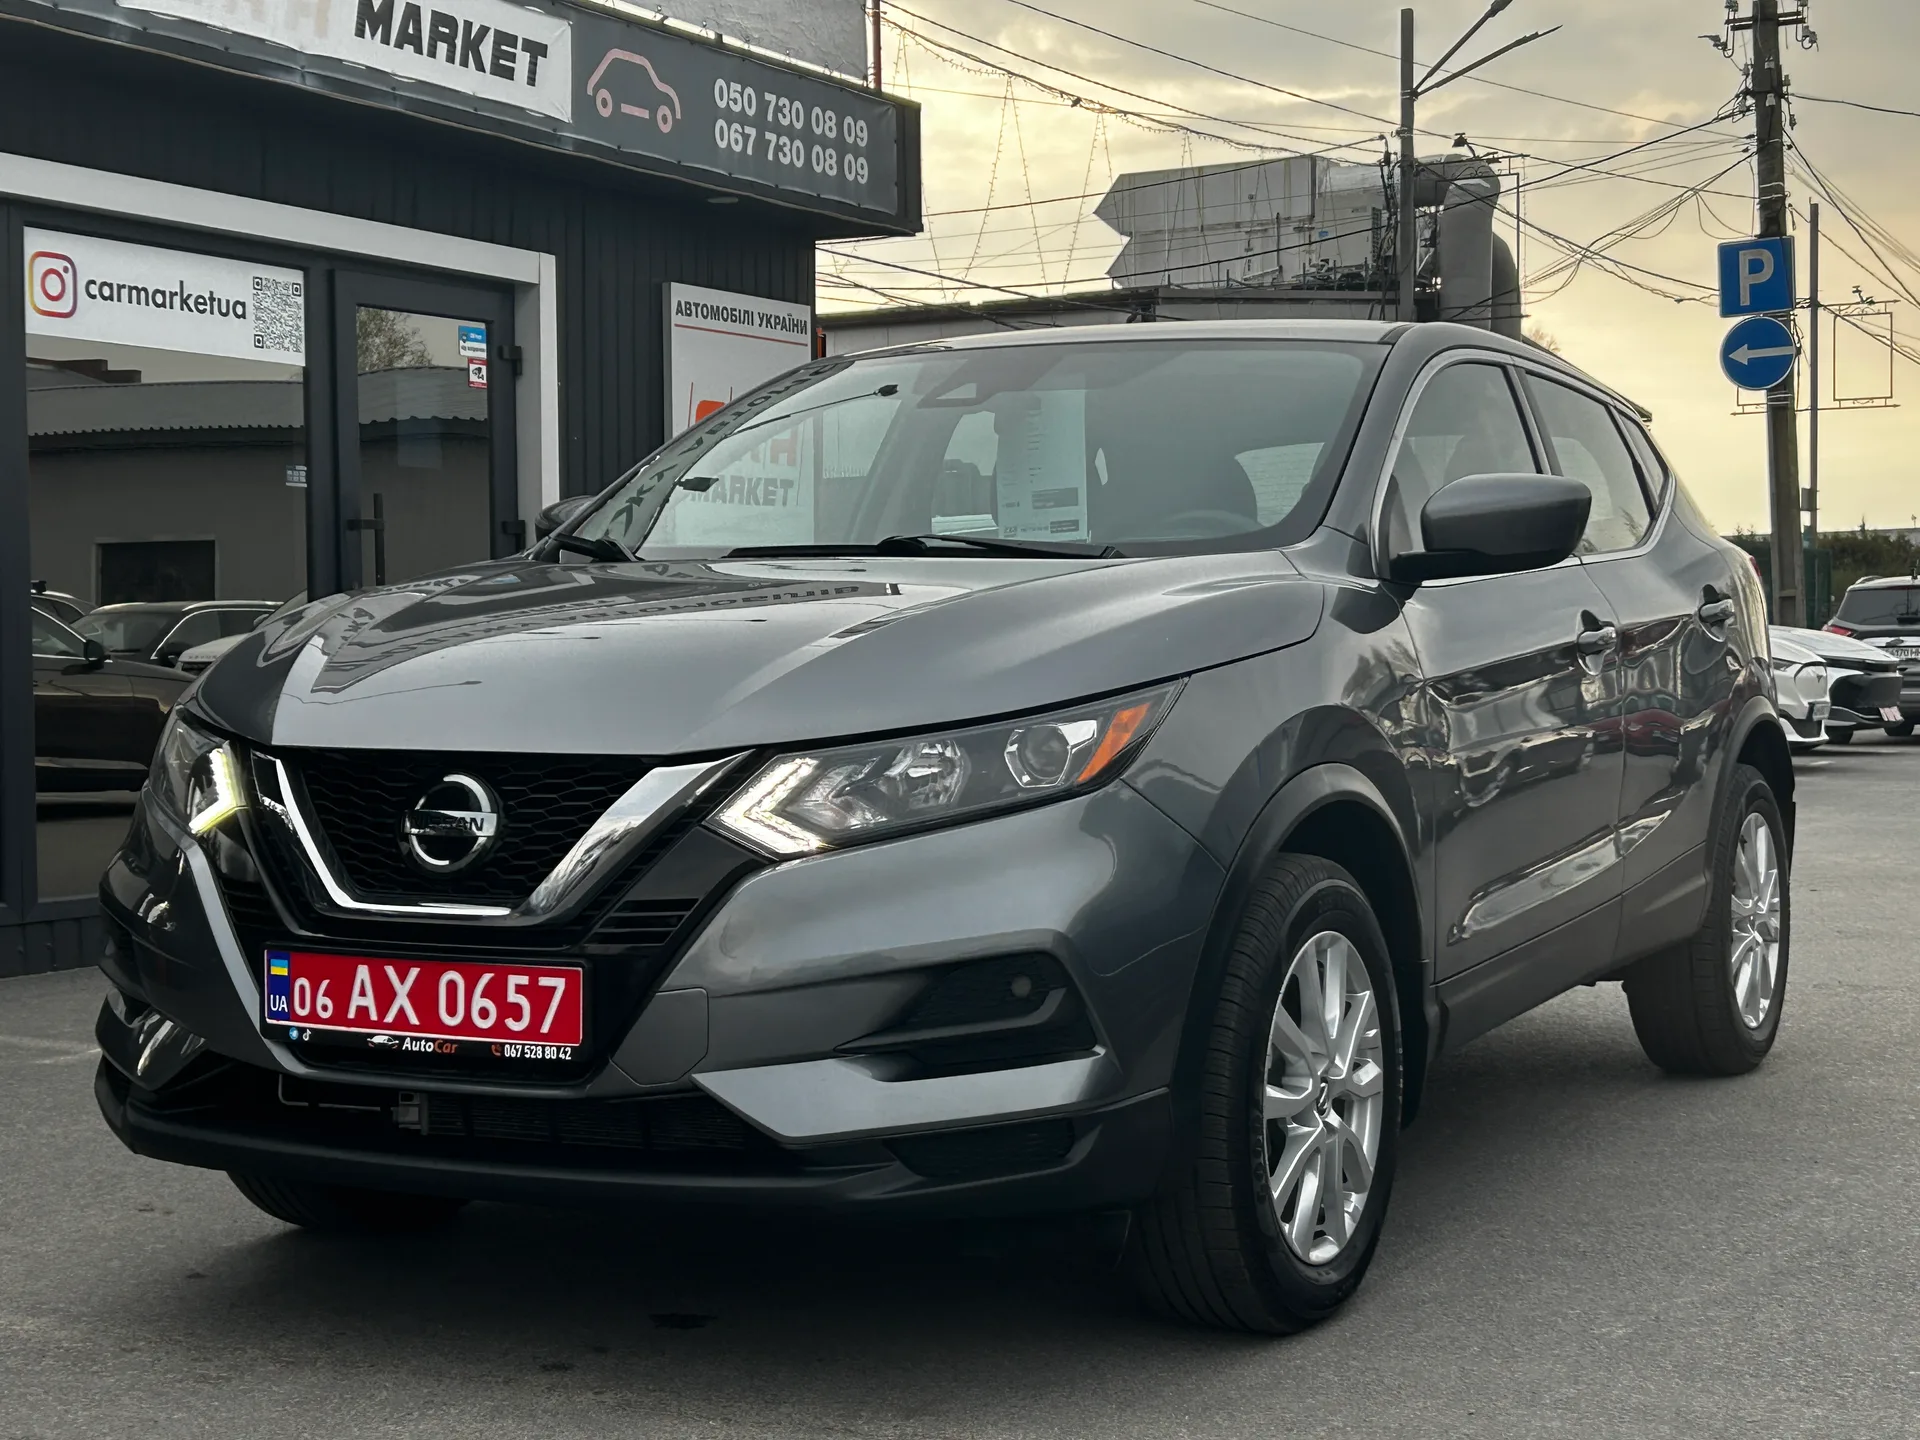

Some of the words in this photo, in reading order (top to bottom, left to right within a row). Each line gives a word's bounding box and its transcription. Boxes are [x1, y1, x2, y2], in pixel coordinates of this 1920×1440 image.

[354, 0, 548, 87] MARKET
[714, 78, 757, 117] 050
[764, 92, 804, 130] 730
[811, 106, 837, 139] 08
[843, 115, 868, 147] 09
[714, 118, 757, 156] 067
[764, 131, 805, 168] 730
[811, 144, 837, 177] 08
[843, 153, 868, 184] 09
[84, 279, 247, 320] carmarketua
[1738, 248, 1775, 307] P
[675, 299, 754, 327] АВТОМОБІЛІ
[757, 312, 808, 336] УКРАЇНИ
[270, 994, 288, 1012] UA
[293, 976, 334, 1019] 06
[347, 964, 421, 1026] AX
[438, 970, 566, 1034] 0657
[402, 1037, 458, 1054] AutoCar
[504, 1044, 521, 1058] 067
[524, 1045, 542, 1059] 528
[544, 1046, 557, 1060] 80
[558, 1046, 572, 1060] 42
